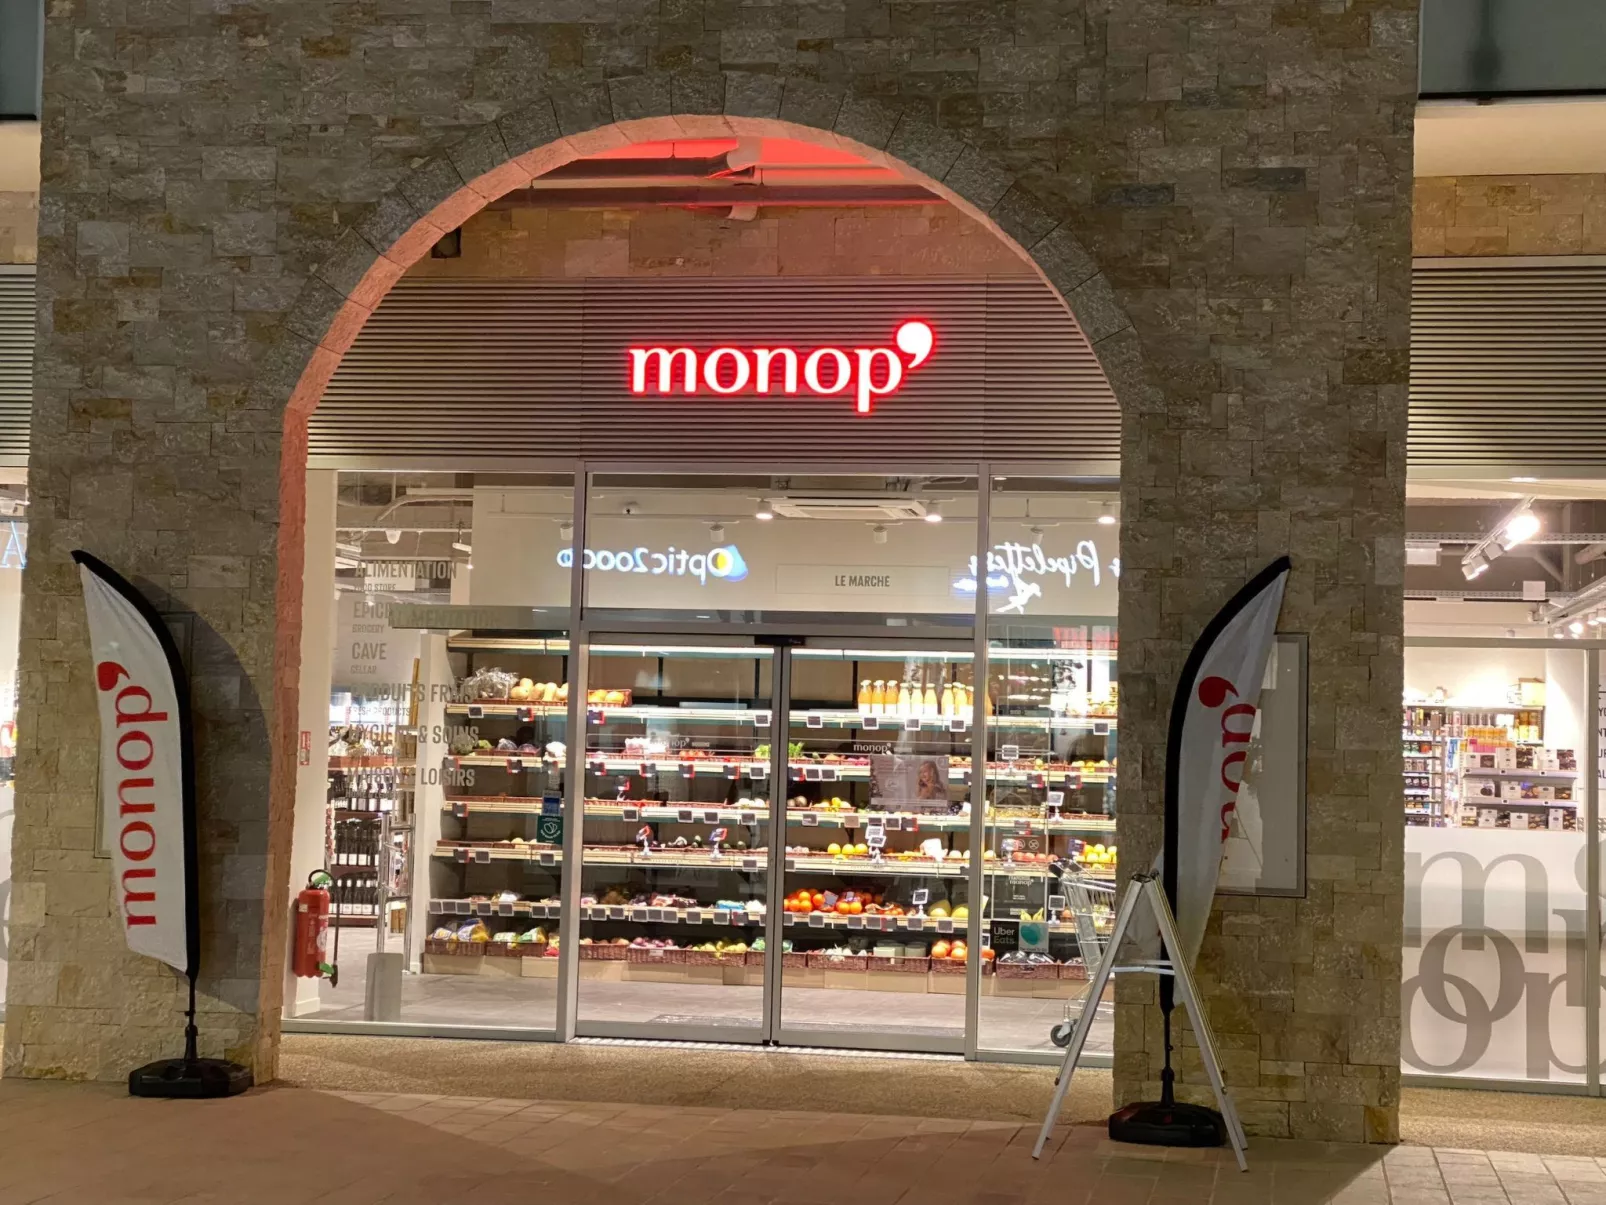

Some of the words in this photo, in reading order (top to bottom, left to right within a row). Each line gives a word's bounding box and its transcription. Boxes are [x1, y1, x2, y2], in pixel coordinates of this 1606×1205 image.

[835, 575, 846, 587] LE
[352, 642, 387, 660] CAVE
[432, 725, 480, 743] SOINS
[420, 768, 475, 787] LOISIRS
[993, 927, 1015, 935] Uber
[993, 936, 1015, 944] Eats
